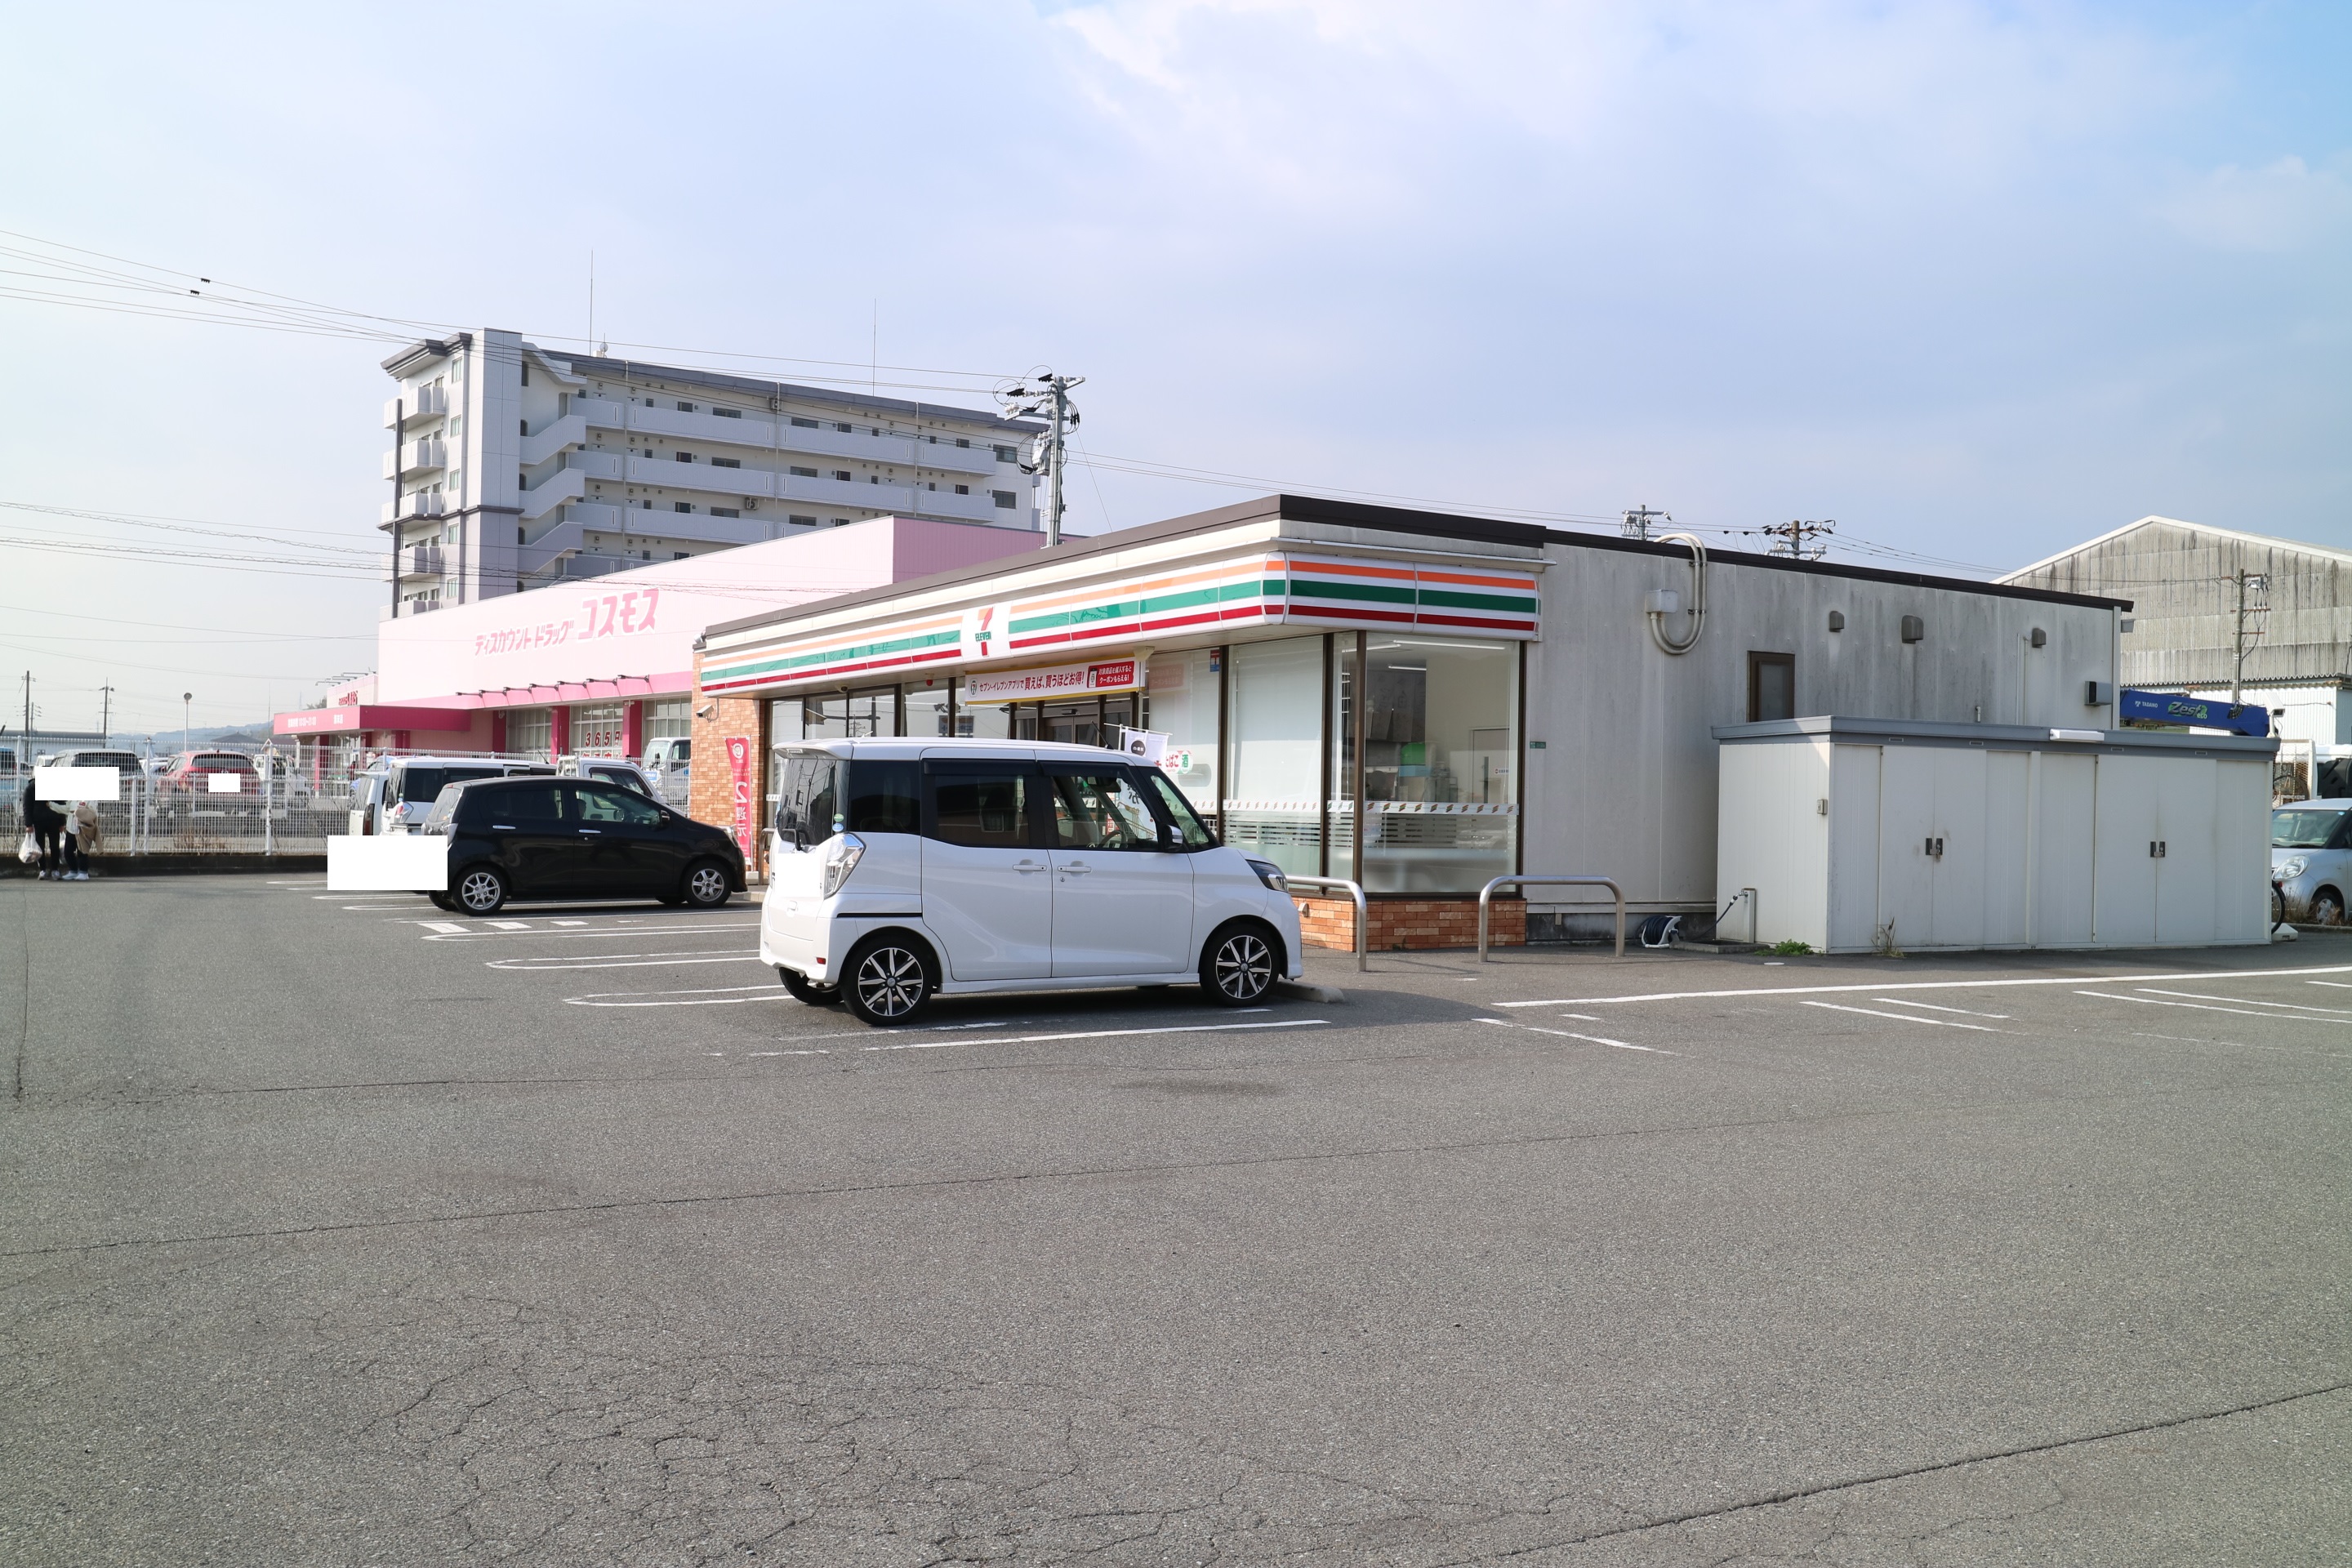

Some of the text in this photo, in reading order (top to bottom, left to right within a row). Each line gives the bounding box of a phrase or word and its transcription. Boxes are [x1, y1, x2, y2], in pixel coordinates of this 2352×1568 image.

[474, 587, 659, 657] ディスカウント ドラッグ コスモス
[2141, 701, 2158, 709] TADANO
[2168, 702, 2202, 717] Zest
[1181, 754, 1189, 768] 酒
